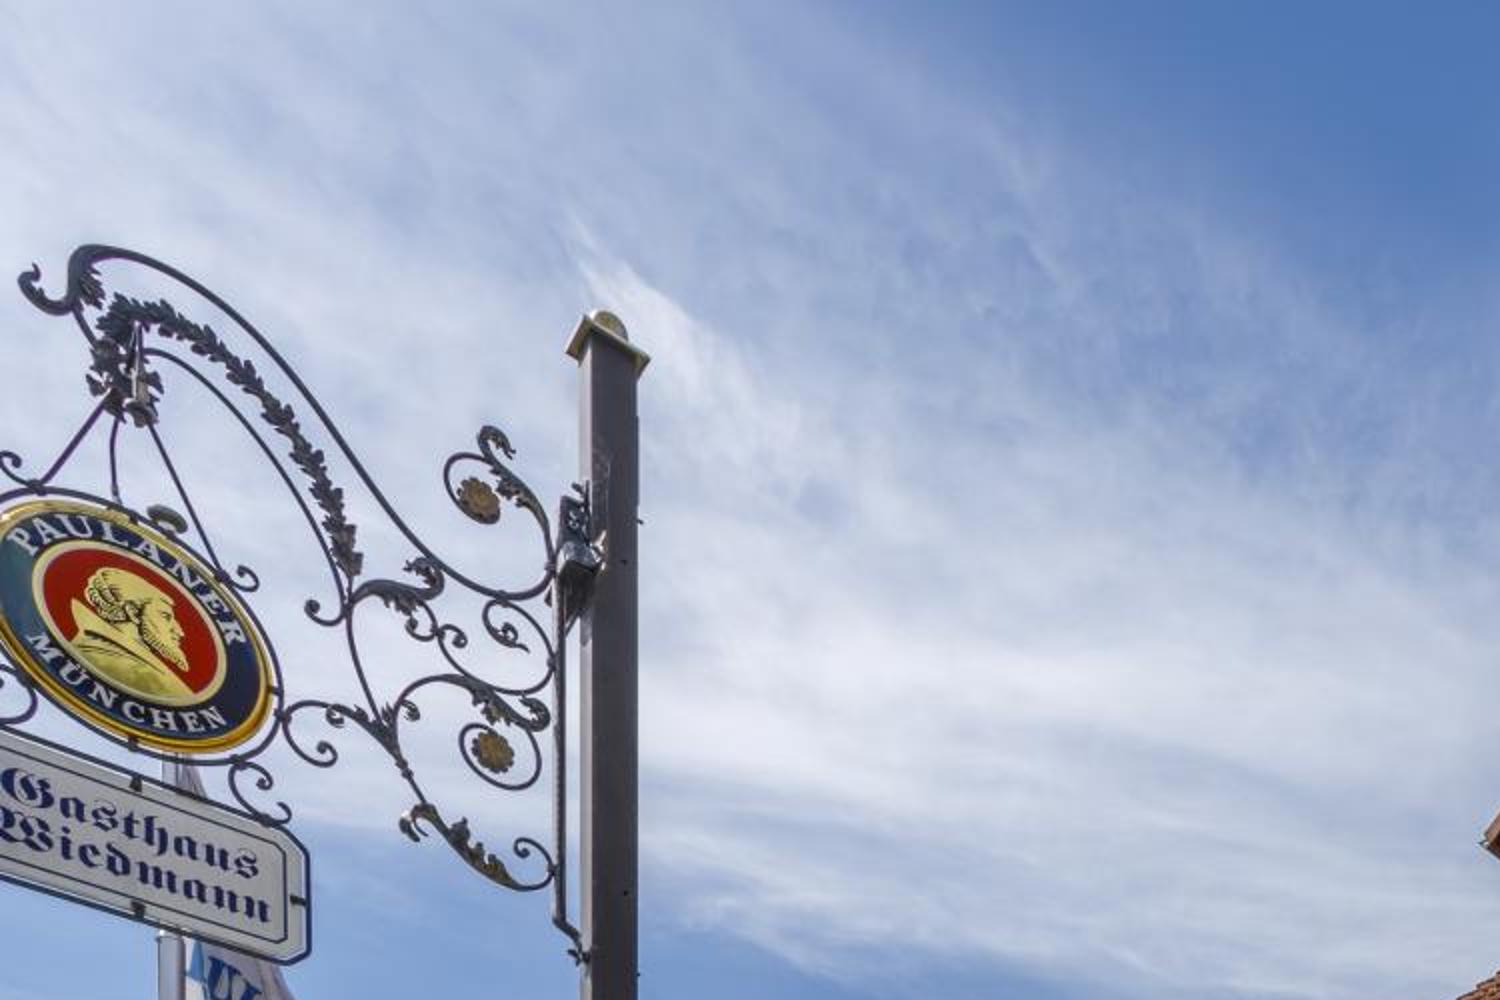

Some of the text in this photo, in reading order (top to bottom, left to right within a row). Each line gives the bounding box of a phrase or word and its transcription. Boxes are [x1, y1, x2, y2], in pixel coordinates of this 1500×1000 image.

[7, 513, 247, 646] PAULANER
[27, 631, 226, 734] MÜNCHEN
[0, 806, 271, 923] Wiedmann
[1, 768, 259, 879] Gasthaus
